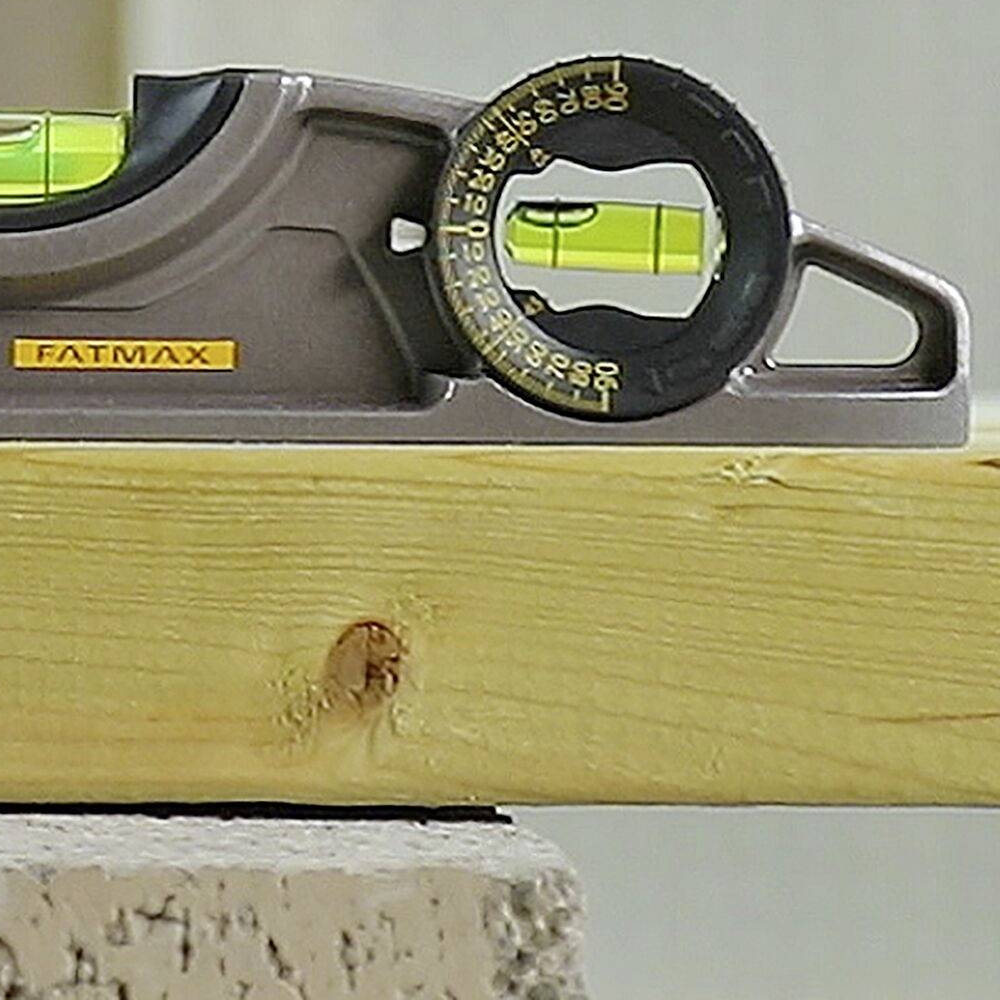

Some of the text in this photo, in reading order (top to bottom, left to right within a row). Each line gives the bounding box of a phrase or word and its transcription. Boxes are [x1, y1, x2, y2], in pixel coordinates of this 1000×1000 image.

[556, 88, 580, 115] 70
[603, 82, 628, 112] 90
[478, 145, 505, 171] 30
[468, 168, 495, 193] 20
[463, 193, 487, 216] 10
[467, 221, 490, 238] 0
[36, 343, 211, 366] FATMAX
[545, 353, 571, 380] 70
[593, 362, 619, 391] 90
